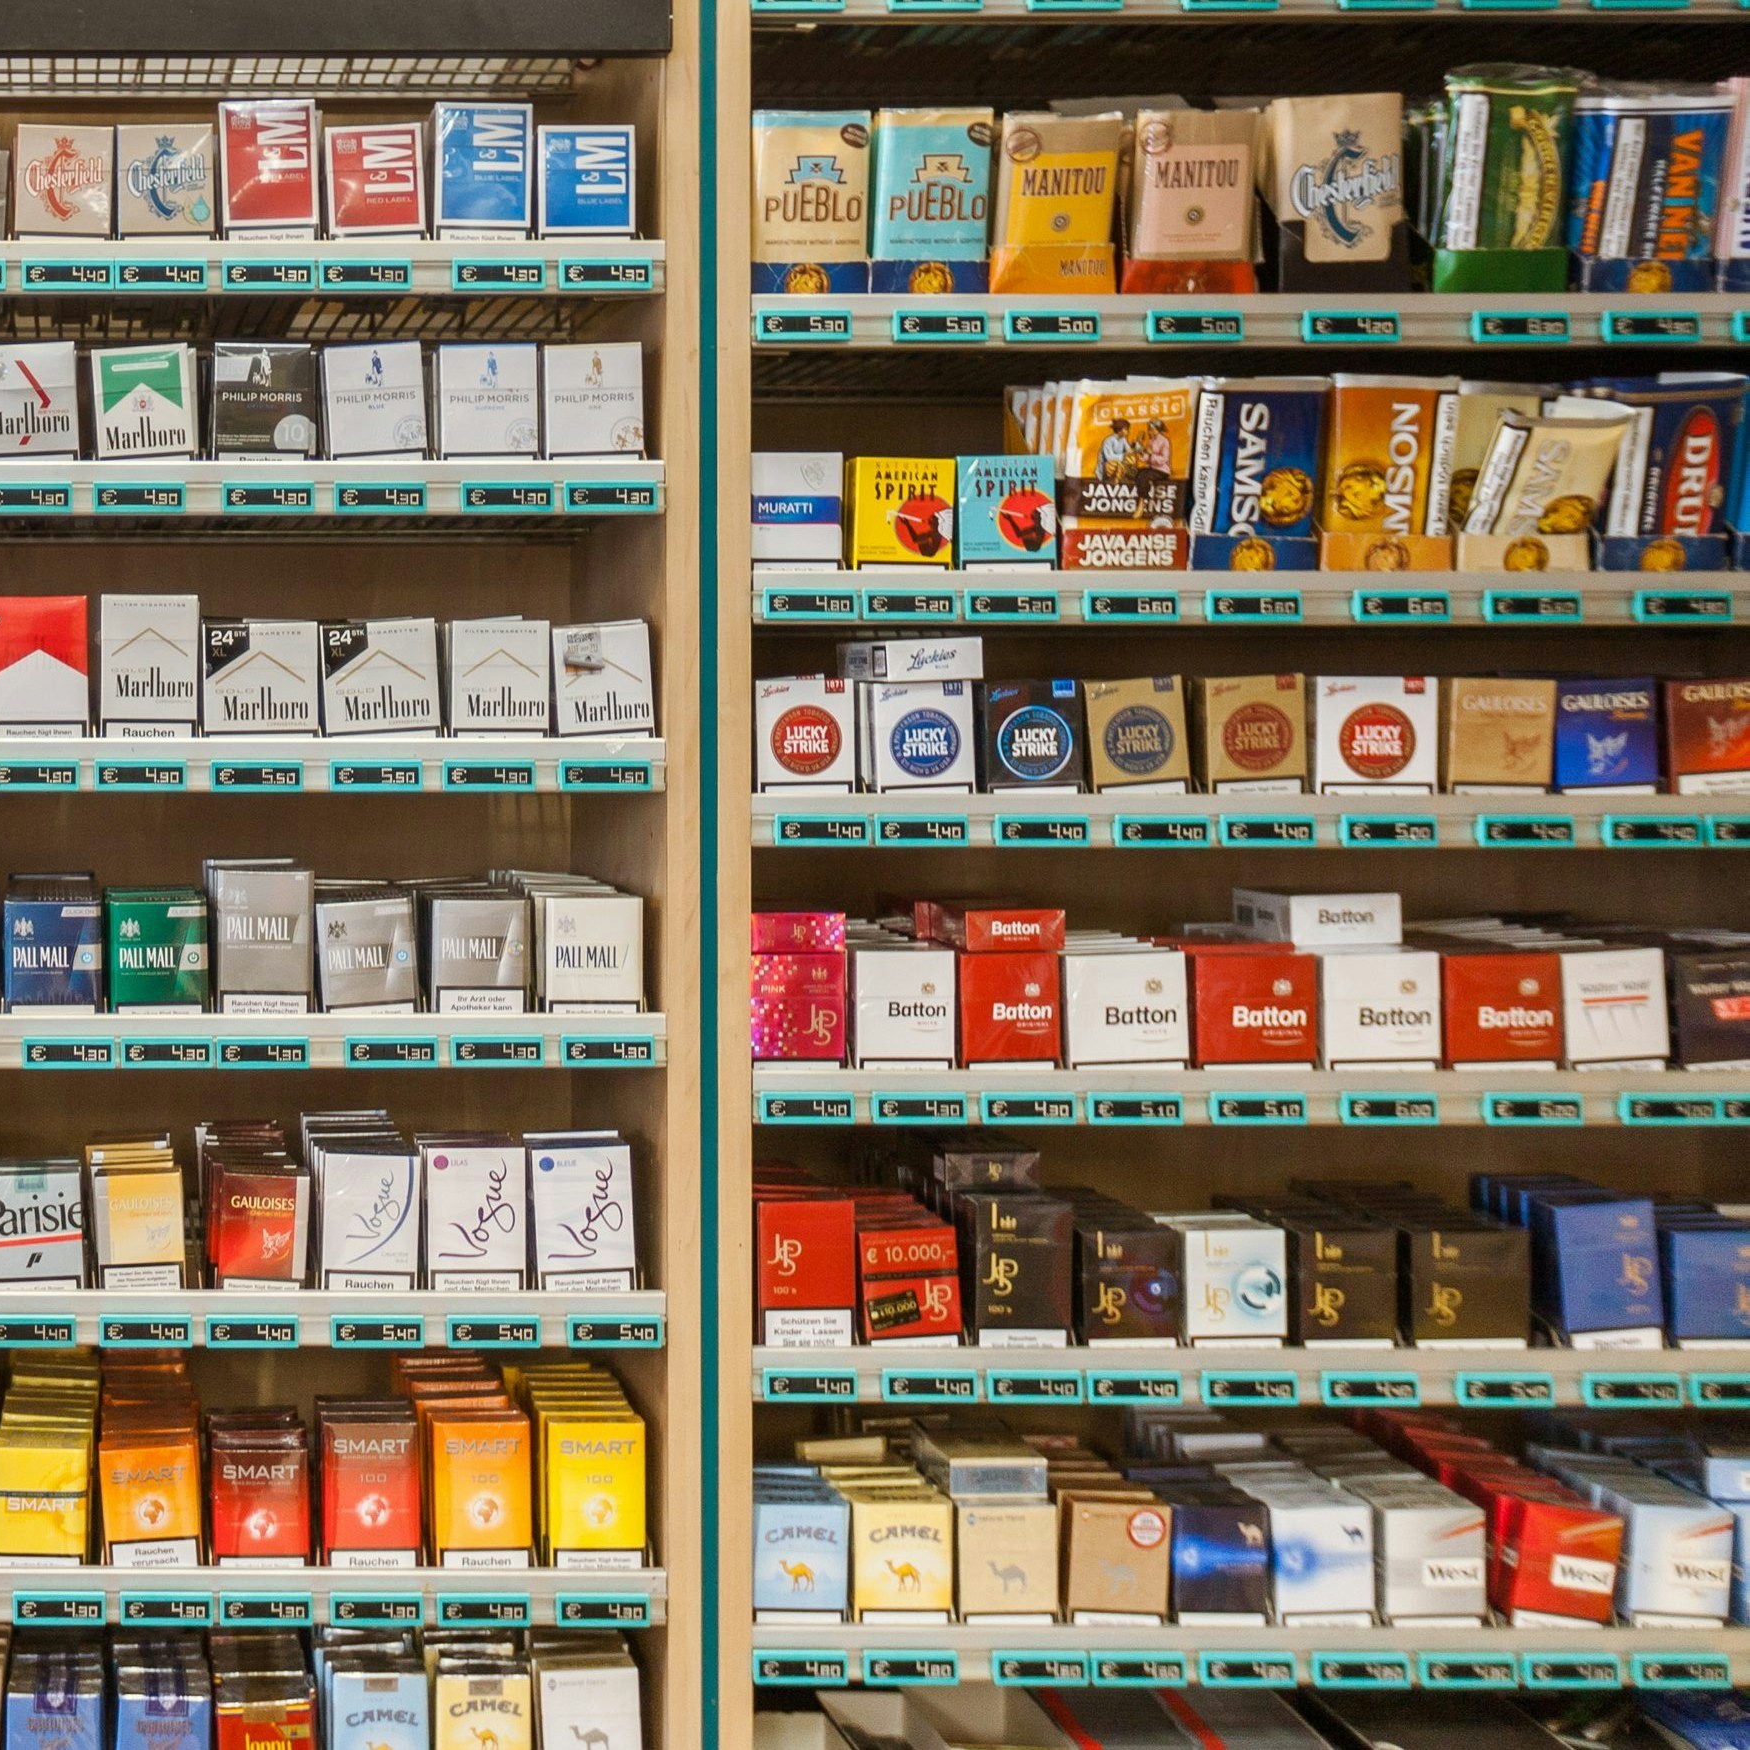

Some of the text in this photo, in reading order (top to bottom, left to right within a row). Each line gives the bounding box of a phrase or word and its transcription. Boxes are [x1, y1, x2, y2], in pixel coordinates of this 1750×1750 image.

[472, 114, 523, 171] L&M
[362, 134, 414, 193] L&M
[576, 136, 626, 195] L&M
[24, 155, 103, 200] Chesterfield
[127, 156, 206, 199] Chesterfield
[1021, 166, 1106, 197] MANITOU
[1154, 159, 1239, 190] MANITOU
[1291, 153, 1400, 218] Chesterfield
[386, 196, 412, 204] LABEL
[765, 183, 862, 223] PUEBLO
[889, 183, 987, 221] PUEBLO
[767, 316, 845, 333] € 5.30
[222, 392, 303, 403] PHILIP MORRIS
[336, 392, 416, 404] PHILIP MORRIS
[1100, 401, 1181, 420] CLASSIC
[106, 416, 186, 452] Marlboro
[875, 470, 938, 481] AMERICAN
[230, 490, 307, 506] € 4.30
[875, 483, 937, 500] SPIRIT
[758, 502, 812, 515] MURATTI
[1077, 534, 1177, 552] JAVAANSE
[1079, 550, 1174, 567] JONGENS
[210, 630, 234, 646] 24
[907, 647, 957, 671] Luckies
[116, 667, 194, 699] Marlboro
[223, 686, 309, 722] Marlboro
[344, 684, 431, 722] Marlboro
[122, 726, 176, 738] Rauchen
[786, 726, 828, 741] LUCKY
[905, 728, 946, 742] LUCKY
[784, 739, 829, 754] STRIKE
[903, 742, 948, 757] STRIKE
[103, 766, 180, 784] € 4.90
[785, 823, 862, 839] € 4.40
[991, 921, 1040, 936] Batton
[120, 946, 176, 970] PALL MALL
[555, 944, 618, 969] PALL MALL
[761, 985, 786, 994] PINK
[888, 1002, 947, 1019] Batton
[992, 1004, 1052, 1021] Batton
[1105, 1007, 1177, 1026] Batton
[1232, 1008, 1307, 1027] Batton
[771, 1101, 847, 1117] € 4.40
[230, 1195, 294, 1210] GAULOISES
[438, 1157, 516, 1260] Vogue
[548, 1158, 624, 1260] Vogue
[867, 1245, 878, 1263] €
[344, 1278, 394, 1290] Rauchen
[340, 1325, 417, 1341] € 5.40
[334, 1438, 410, 1456] SMART
[110, 1464, 187, 1484] SMART
[223, 1464, 300, 1480] SMART
[360, 1474, 386, 1483] 100
[765, 1525, 838, 1544] CAMEL
[134, 1546, 174, 1558] Rauchen
[462, 1556, 512, 1567] Rauchen
[1427, 1563, 1479, 1581] West
[338, 1602, 416, 1620] € 4.30
[345, 1708, 418, 1727] CAMEL
